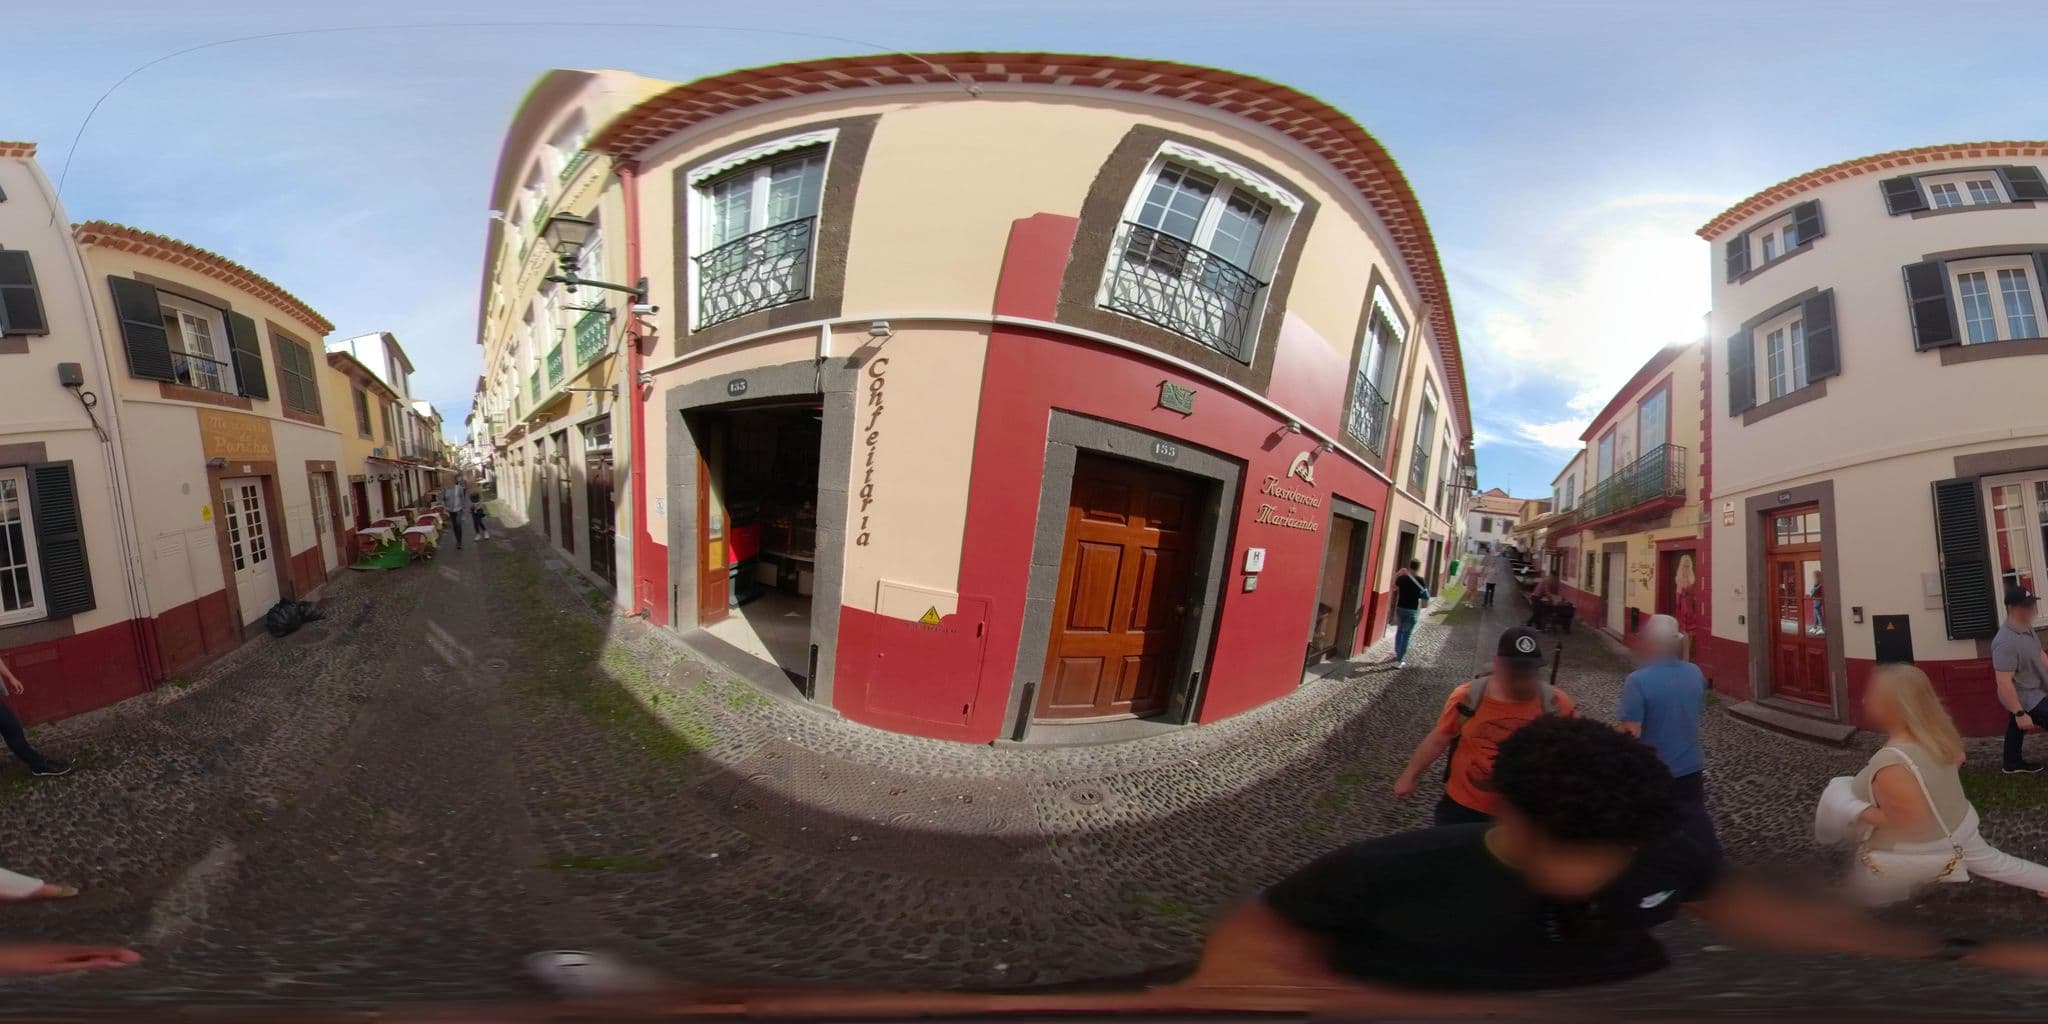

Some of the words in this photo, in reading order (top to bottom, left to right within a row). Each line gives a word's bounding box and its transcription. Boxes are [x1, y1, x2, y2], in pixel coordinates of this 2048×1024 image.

[856, 357, 889, 547] Confeitaria
[1155, 443, 1175, 457] 155
[1262, 475, 1321, 508] Residencial
[1253, 551, 1260, 561] H
